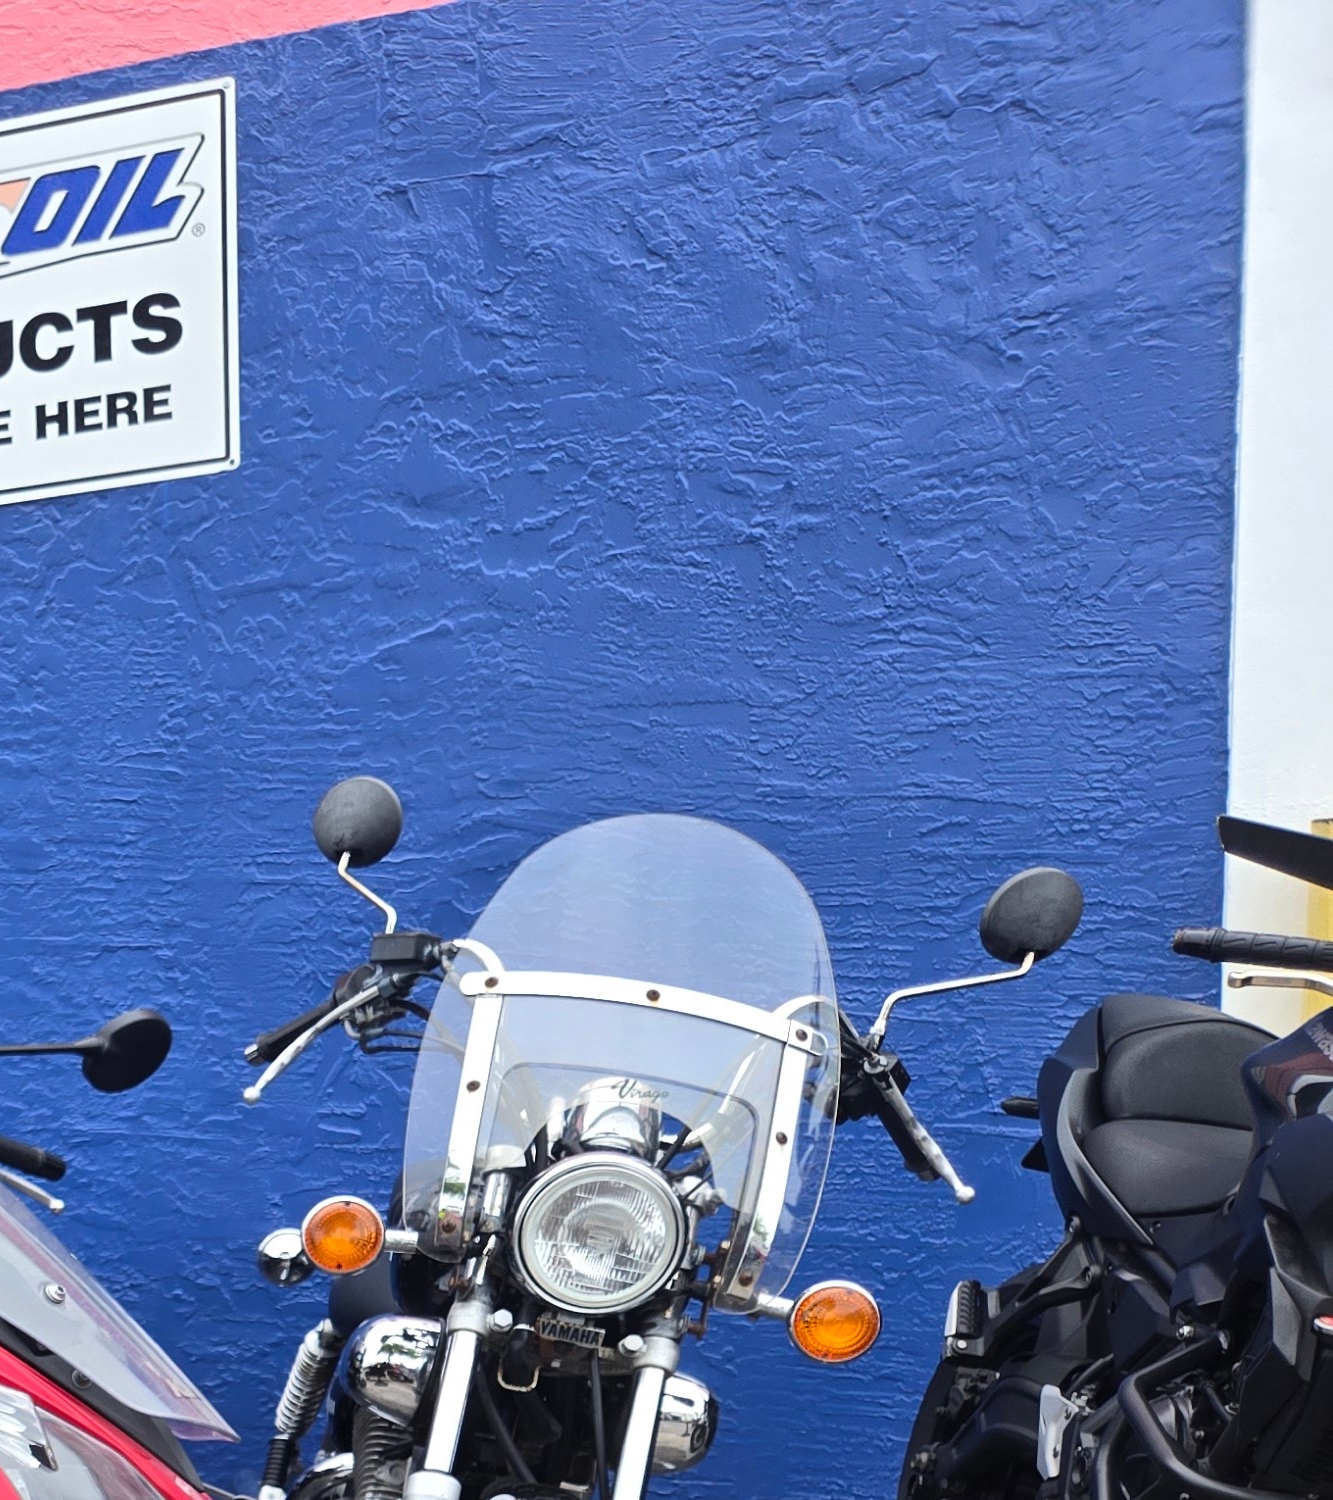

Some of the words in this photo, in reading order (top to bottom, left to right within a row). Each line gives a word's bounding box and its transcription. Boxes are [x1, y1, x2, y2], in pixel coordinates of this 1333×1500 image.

[36, 383, 173, 441] HERE
[611, 1078, 670, 1103] Virago
[541, 1320, 600, 1346] YAMAHA
